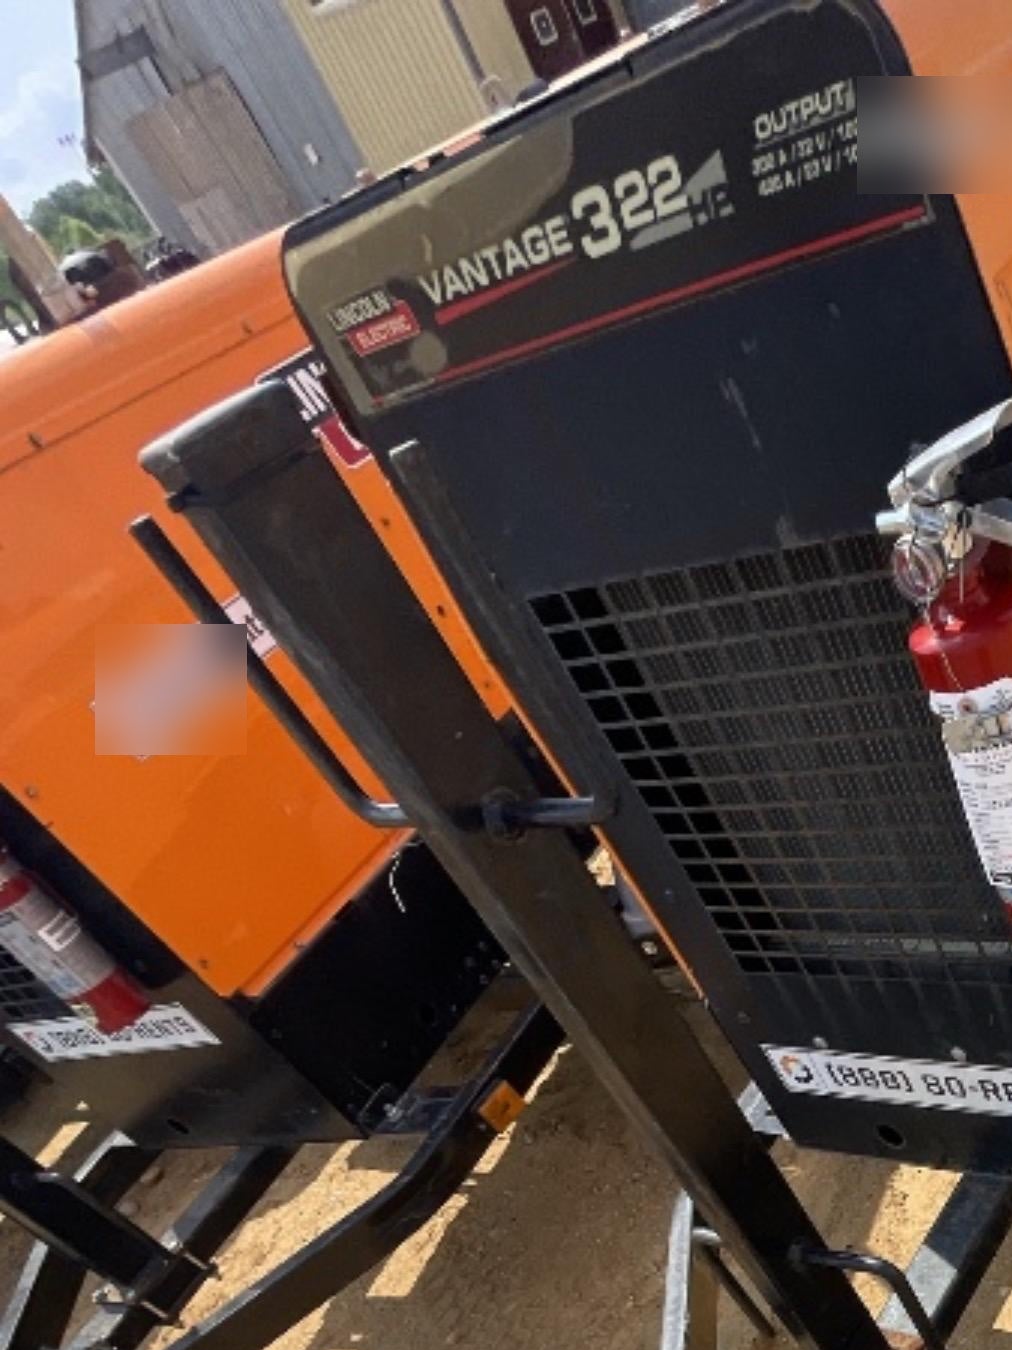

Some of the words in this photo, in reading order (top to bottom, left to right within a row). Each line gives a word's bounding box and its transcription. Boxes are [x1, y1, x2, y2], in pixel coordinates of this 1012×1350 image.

[416, 212, 574, 306] VANTAGE
[570, 154, 690, 260] 322
[325, 289, 392, 332] LINCOLN
[825, 1064, 914, 1094] (888)
